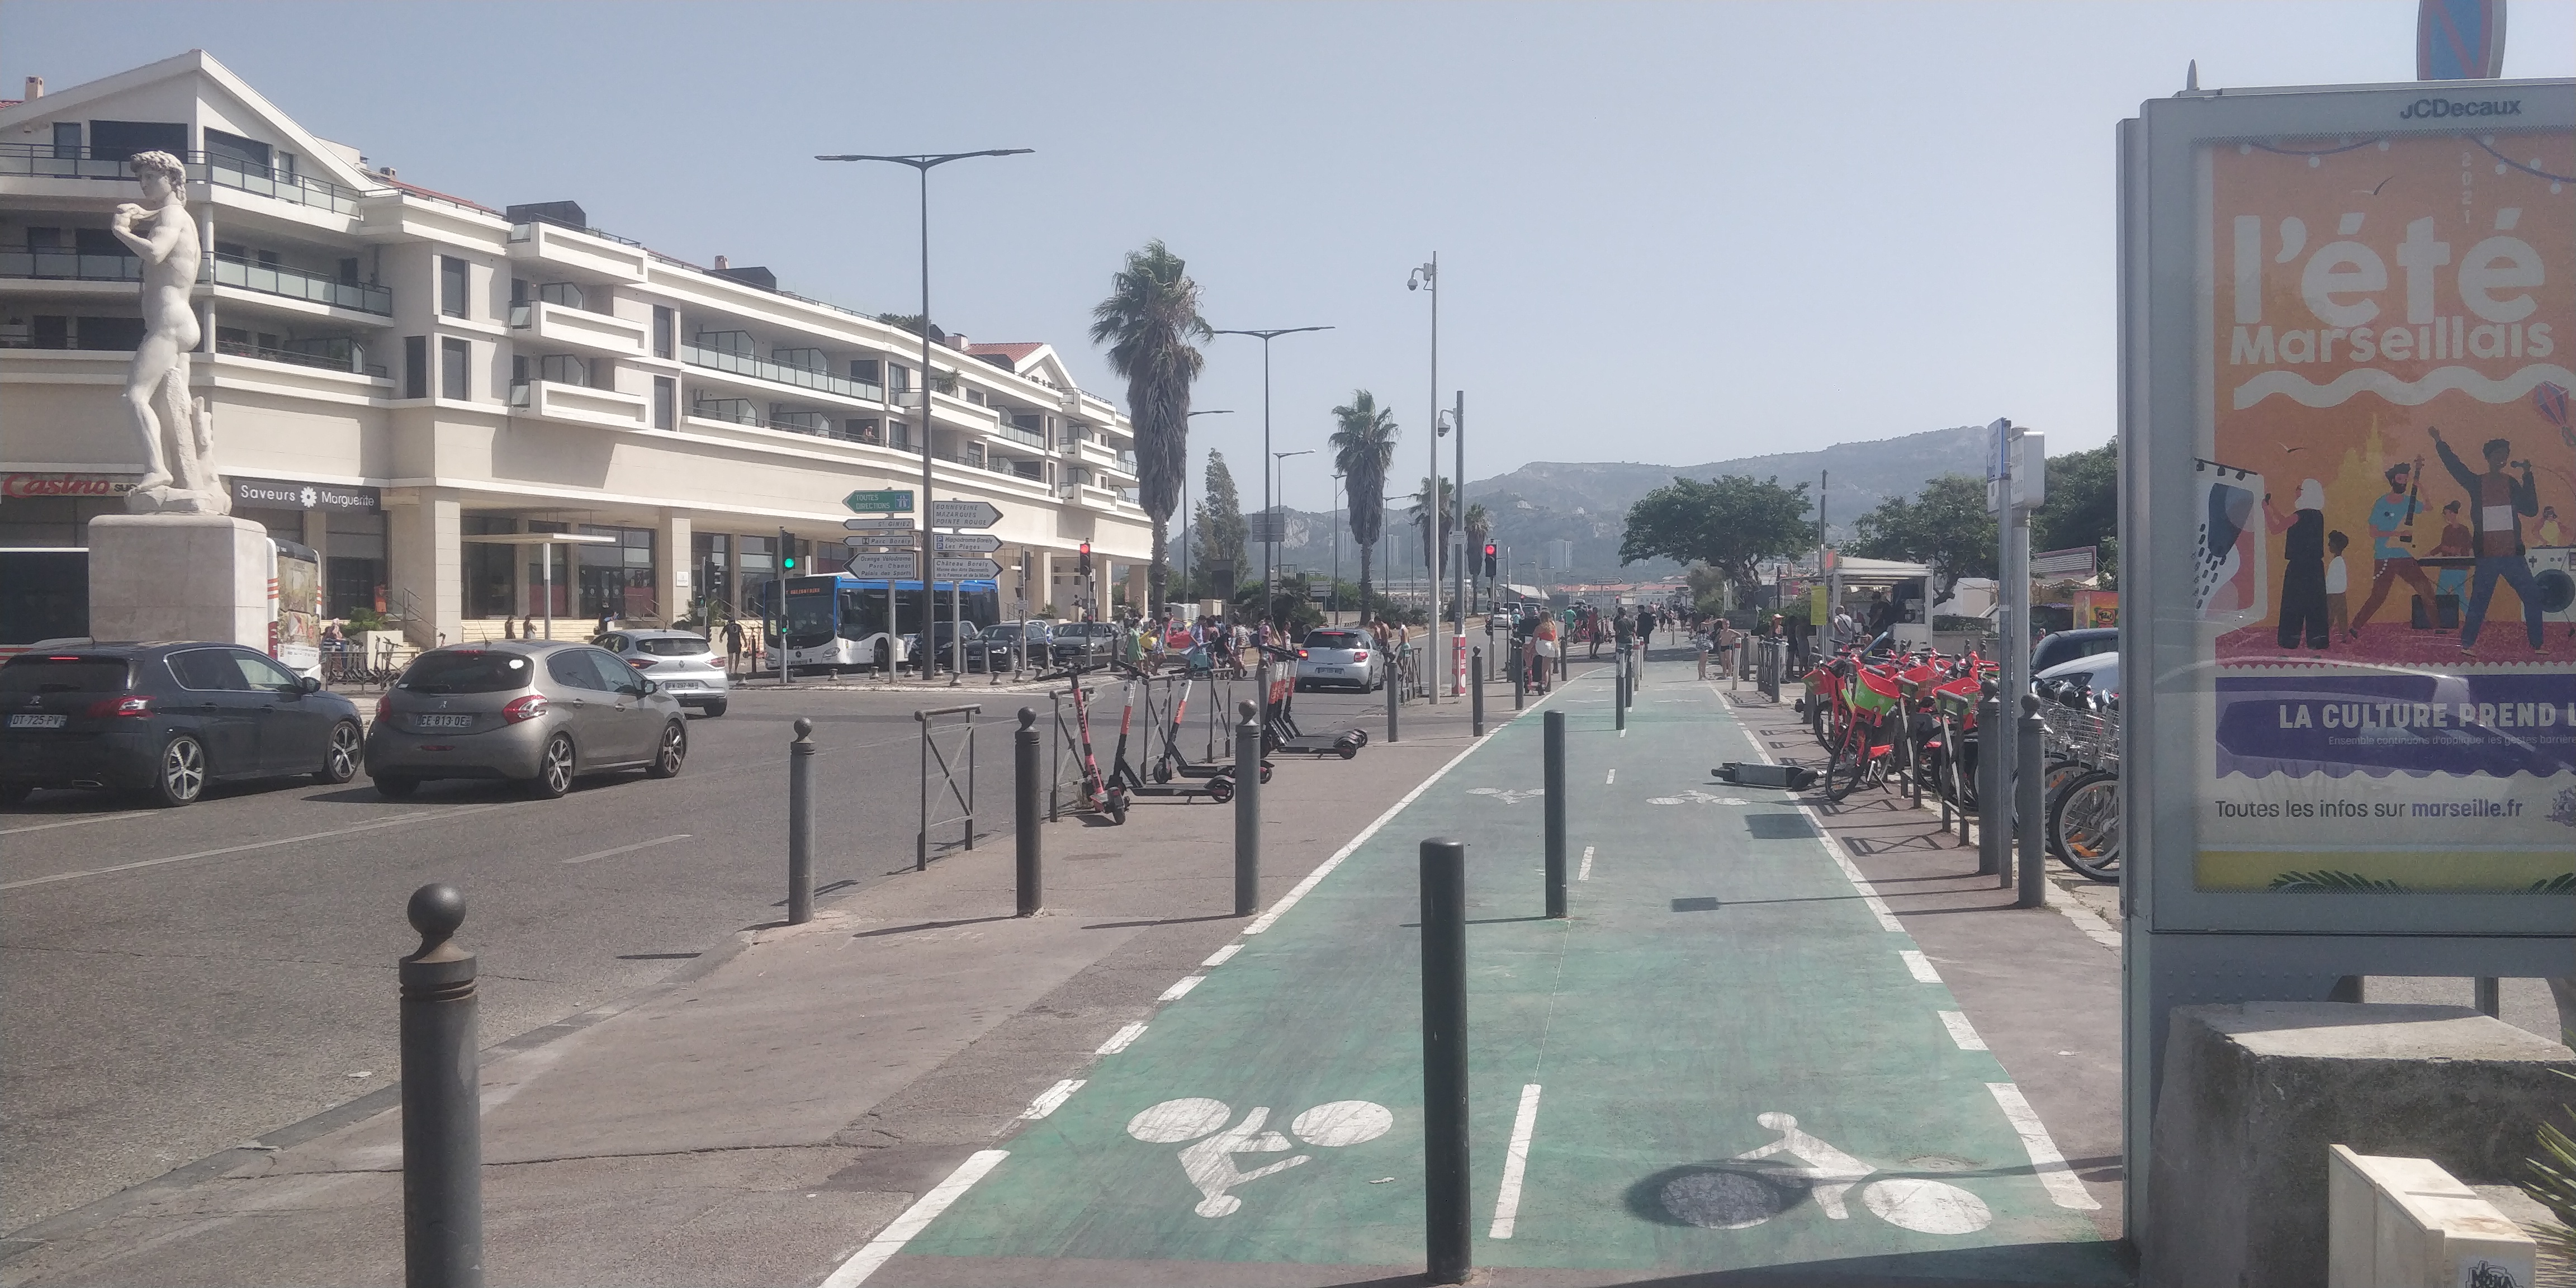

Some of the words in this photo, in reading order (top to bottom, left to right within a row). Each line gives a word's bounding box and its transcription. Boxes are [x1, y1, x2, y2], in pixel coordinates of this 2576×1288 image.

[2400, 98, 2522, 119] JCDecaux
[2461, 151, 2473, 225] 2021
[2234, 207, 2545, 329] l'été
[2231, 316, 2554, 364] Marseillais
[3, 473, 110, 498] Casino
[240, 485, 296, 501] Saveurs
[321, 491, 375, 508] Marguerite
[12, 716, 60, 725] DT-725-PV
[2280, 704, 2312, 728] LA
[2322, 703, 2447, 728] CULTURE
[2459, 702, 2556, 727] PREND
[2328, 736, 2375, 745] Ensemble
[2376, 736, 2430, 745] continuons
[2432, 735, 2484, 746] d'appliquer
[2488, 735, 2502, 745] les
[2504, 736, 2538, 746] gestes
[2215, 801, 2279, 817] Toutes
[2285, 799, 2314, 817] les
[2321, 799, 2368, 817] infos
[2374, 802, 2405, 817] sur
[2412, 799, 2523, 817] marseille.fr
